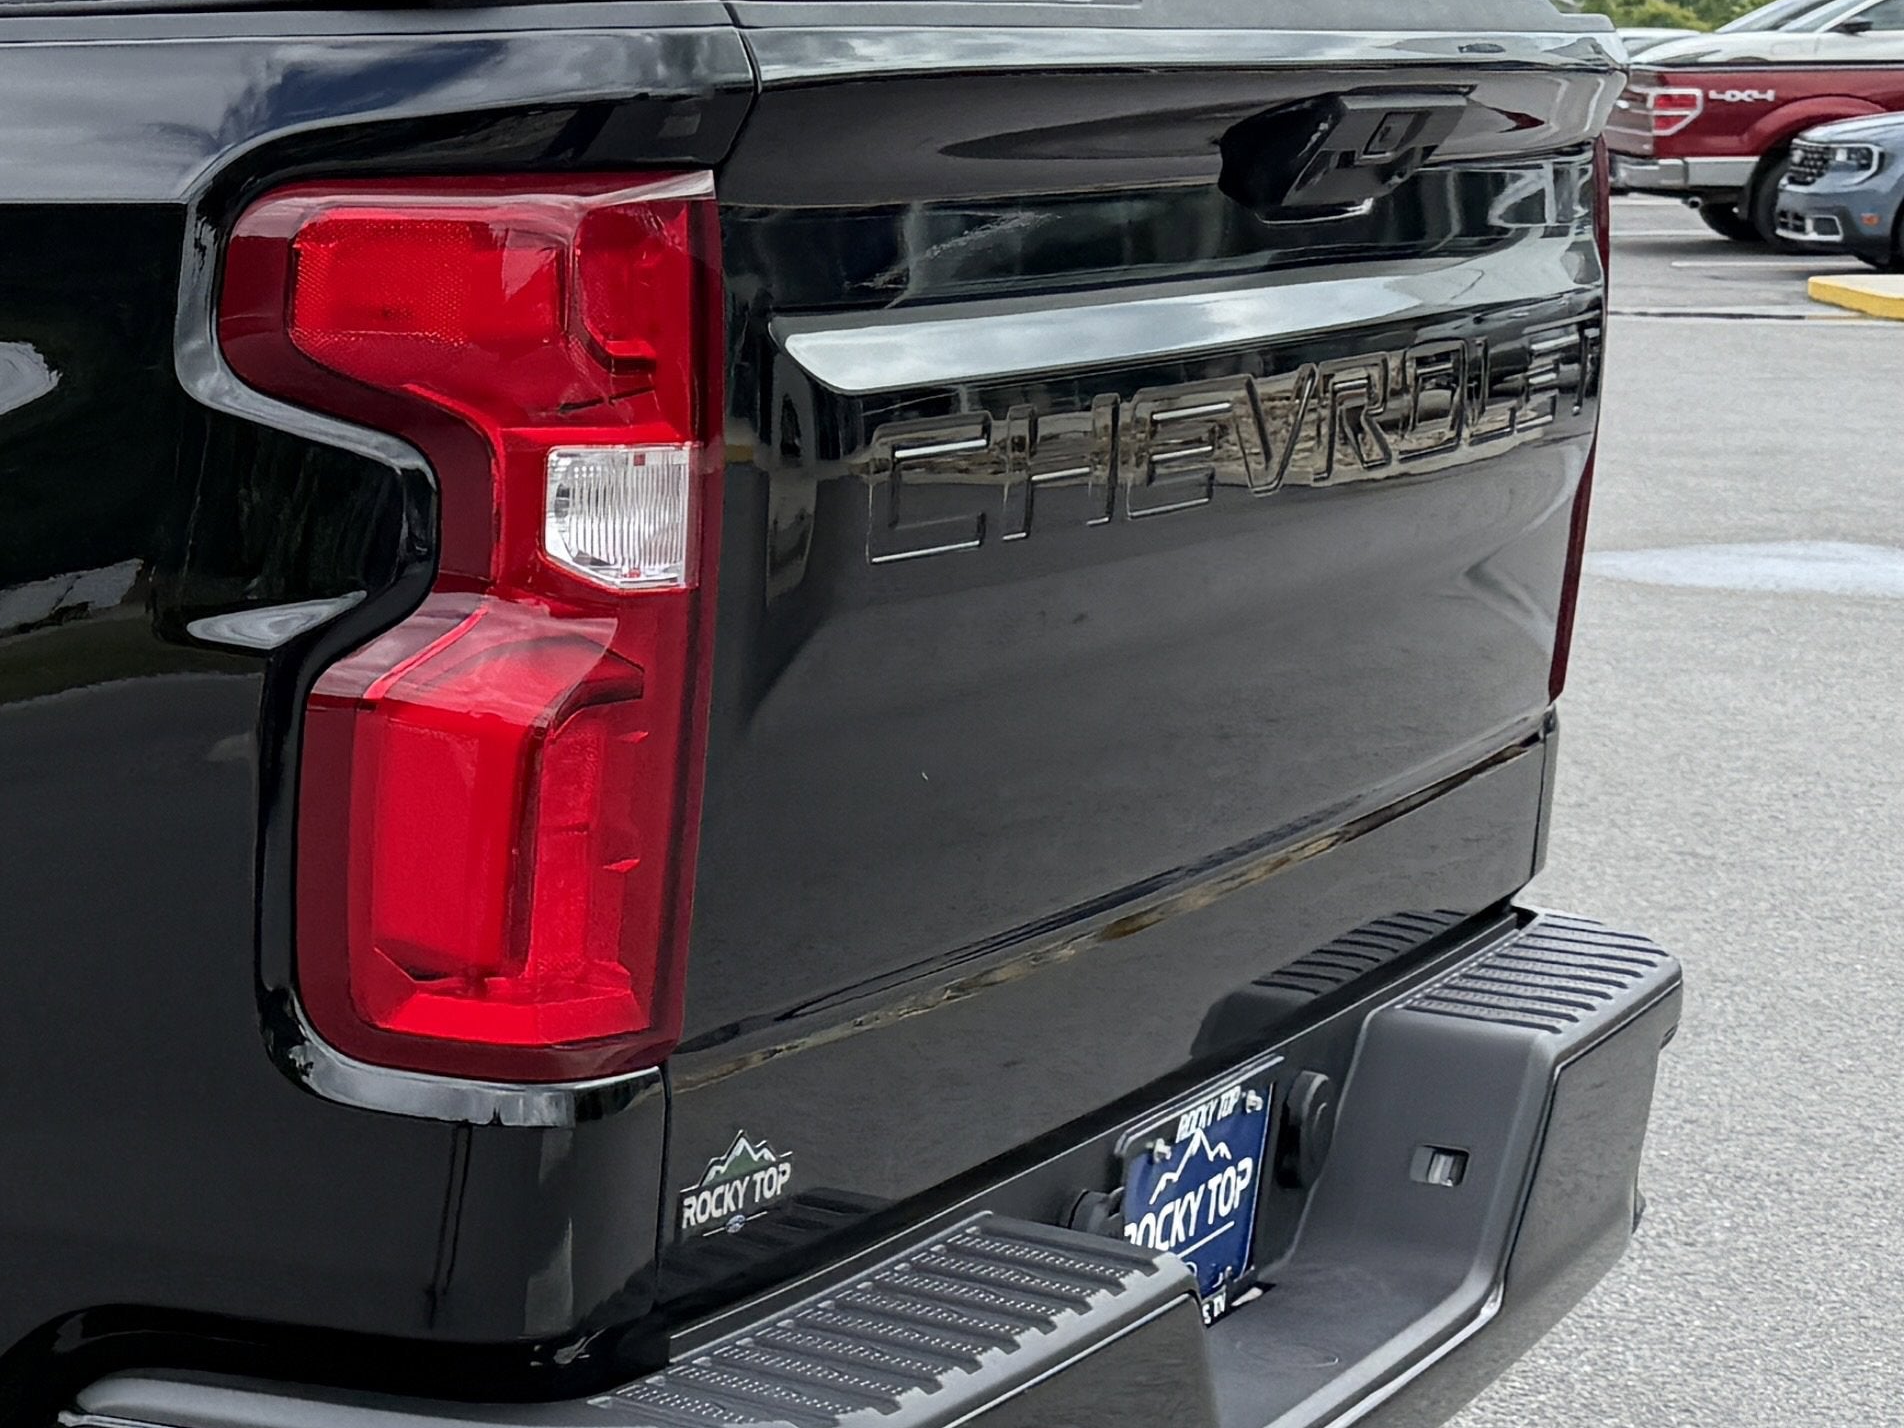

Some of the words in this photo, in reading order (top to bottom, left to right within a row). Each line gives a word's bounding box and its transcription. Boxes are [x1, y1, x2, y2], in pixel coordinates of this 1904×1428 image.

[866, 320, 1603, 565] CHEVROLET
[1175, 1097, 1216, 1143] ROCKY
[1217, 1085, 1242, 1121] TOP
[682, 1175, 750, 1229] ROCKY
[752, 1162, 792, 1203] TOP
[1207, 1156, 1254, 1225] TOP
